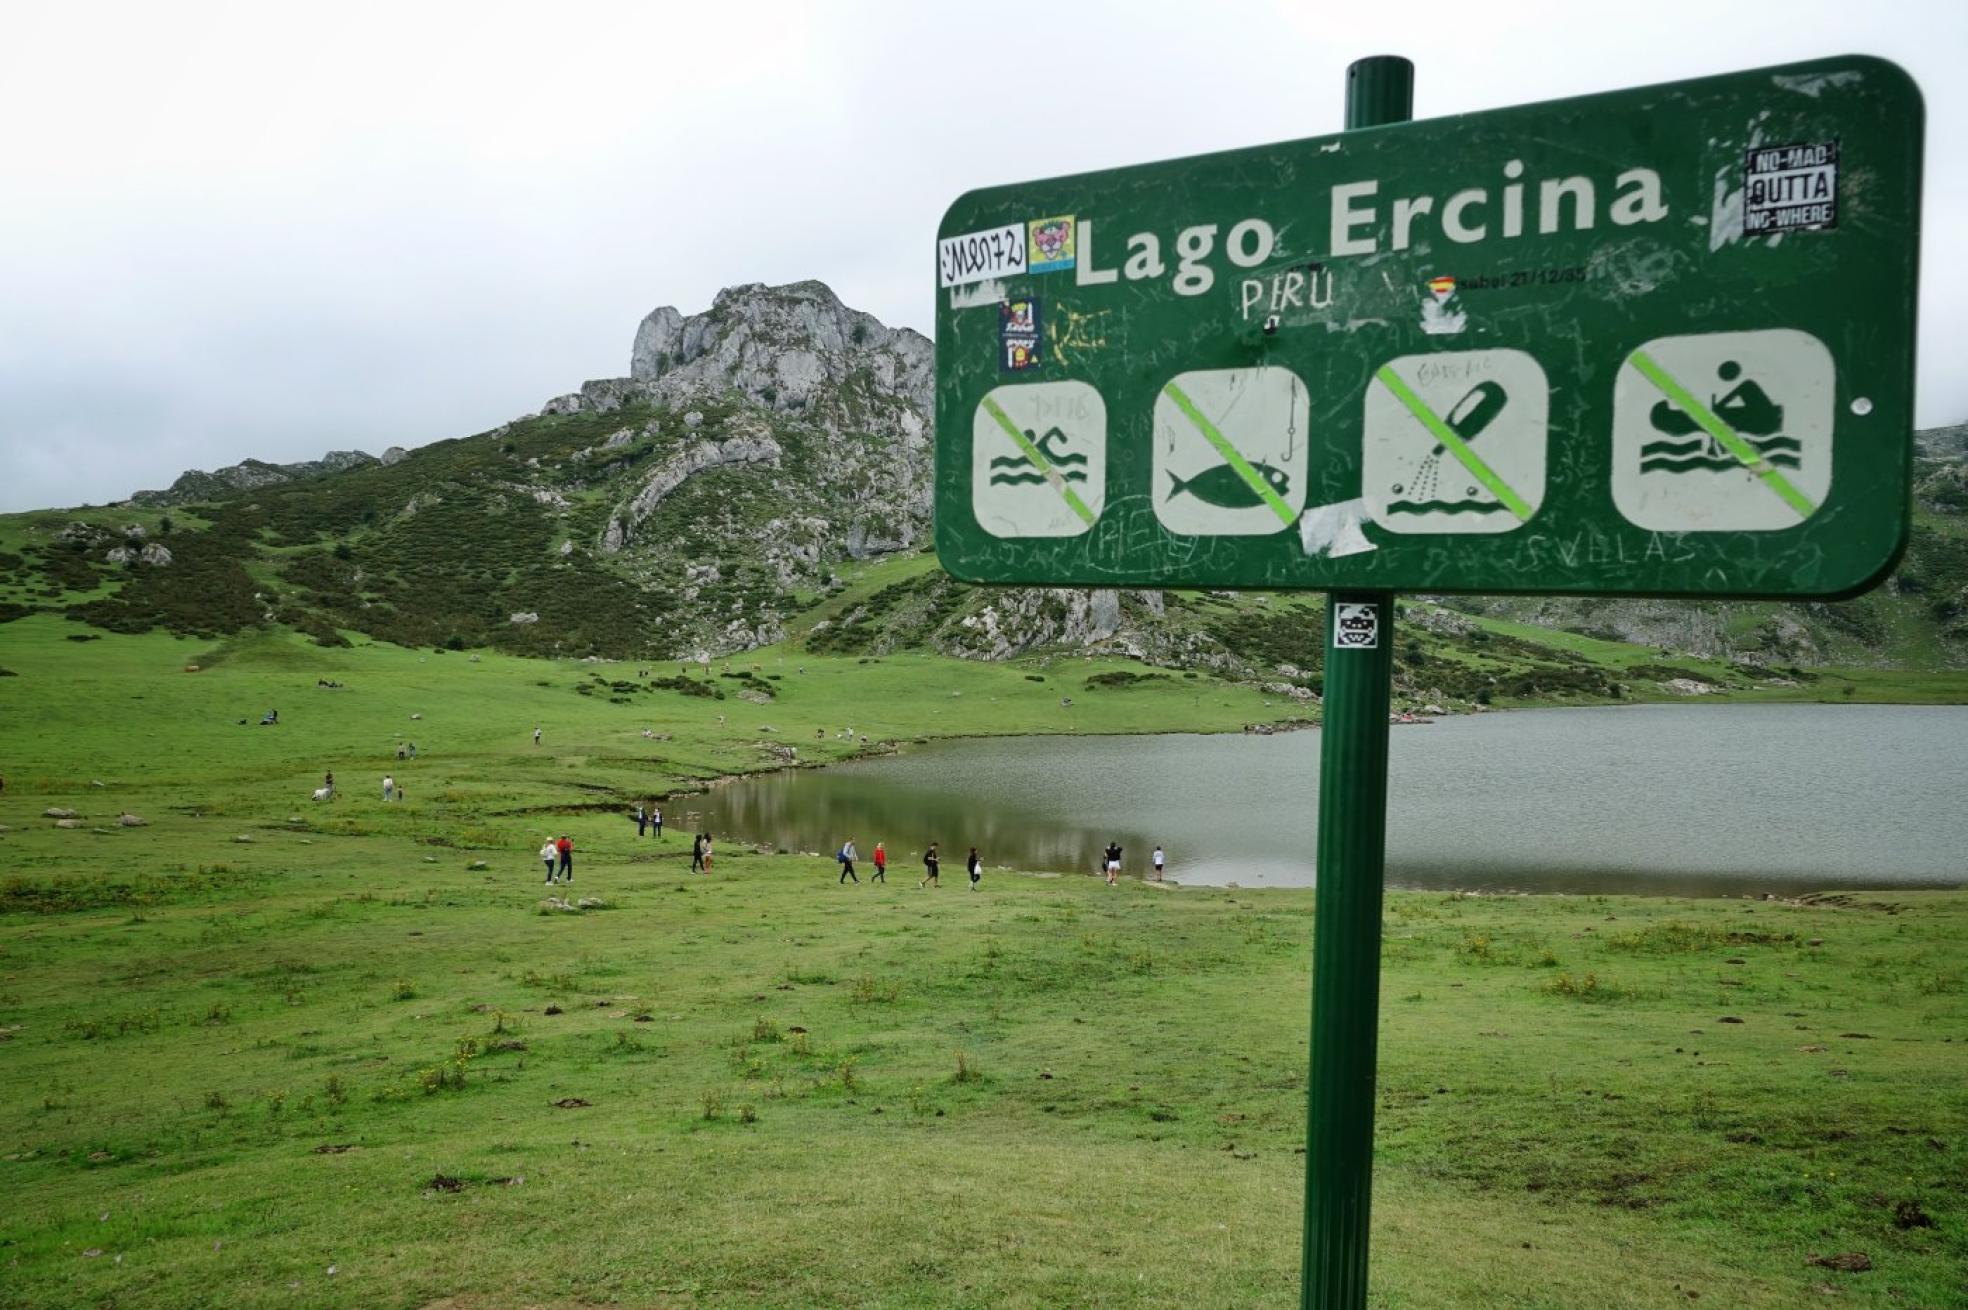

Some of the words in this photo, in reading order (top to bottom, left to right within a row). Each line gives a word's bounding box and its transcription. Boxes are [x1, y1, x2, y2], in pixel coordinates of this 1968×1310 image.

[1076, 218, 1275, 296] Lago
[1330, 158, 1670, 258] Ercina
[1749, 171, 1831, 206] OUTTA
